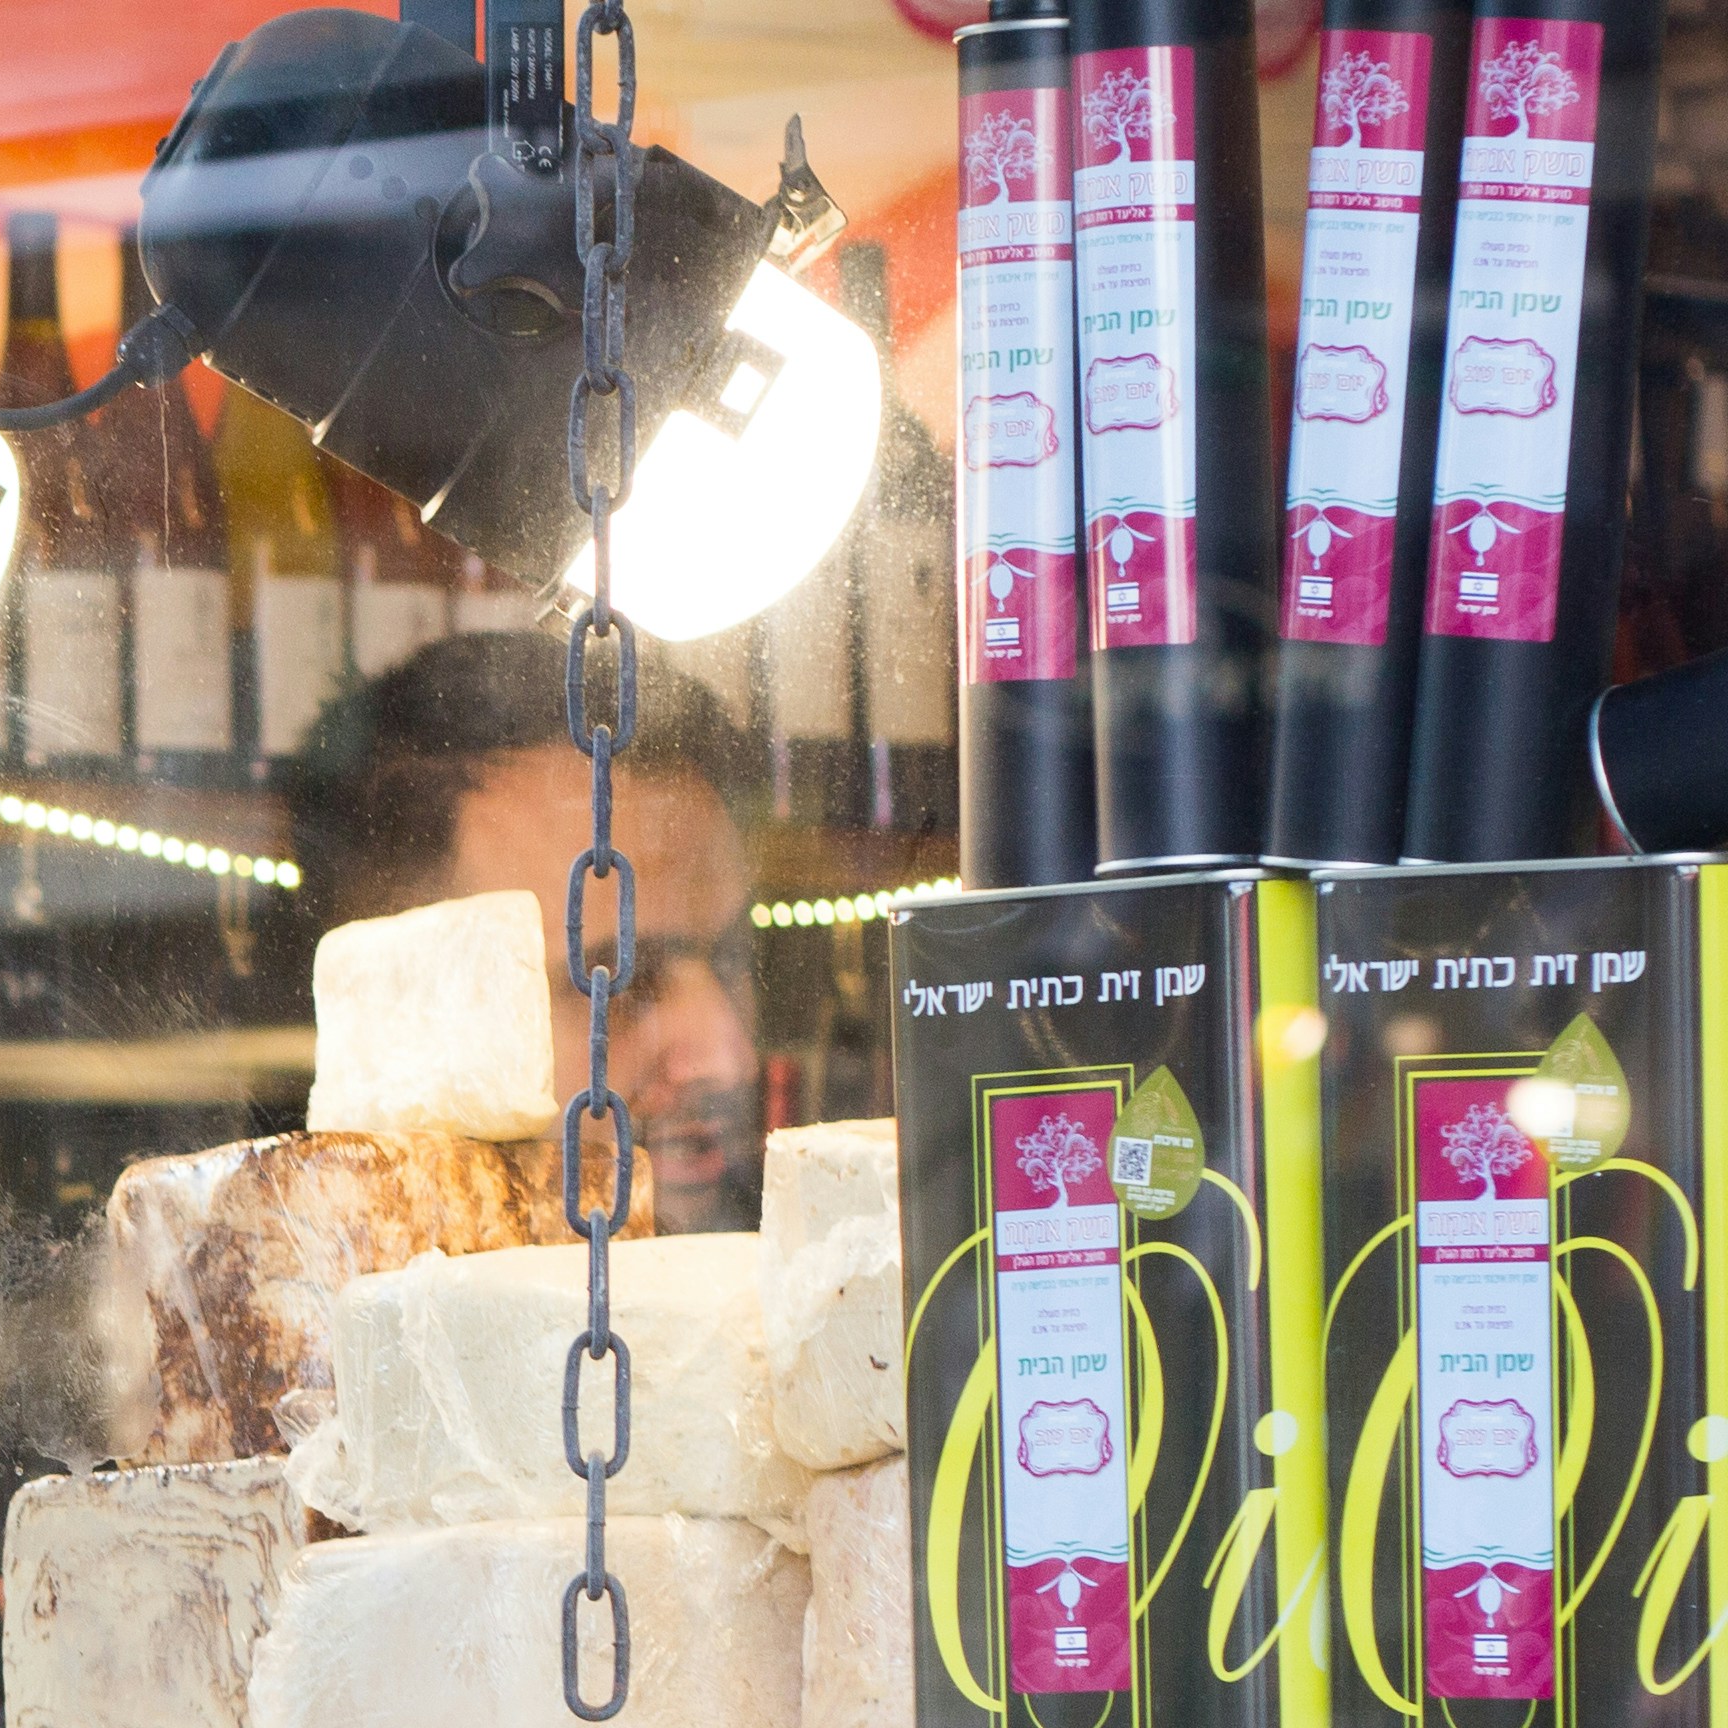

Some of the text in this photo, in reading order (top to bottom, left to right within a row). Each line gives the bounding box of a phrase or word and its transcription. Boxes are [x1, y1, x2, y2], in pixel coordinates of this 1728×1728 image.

[1355, 158, 1415, 190] משק
[1522, 149, 1584, 181] משק
[1345, 299, 1393, 325] שמן
[1457, 289, 1562, 318] שמן הבית
[1324, 950, 1646, 994] שמן זית כתית ישראלי
[904, 963, 1206, 1017] שמן זית כתית ישראלי
[1018, 1352, 1108, 1380] שמן הבית
[1439, 1350, 1534, 1378] שמן הבית
